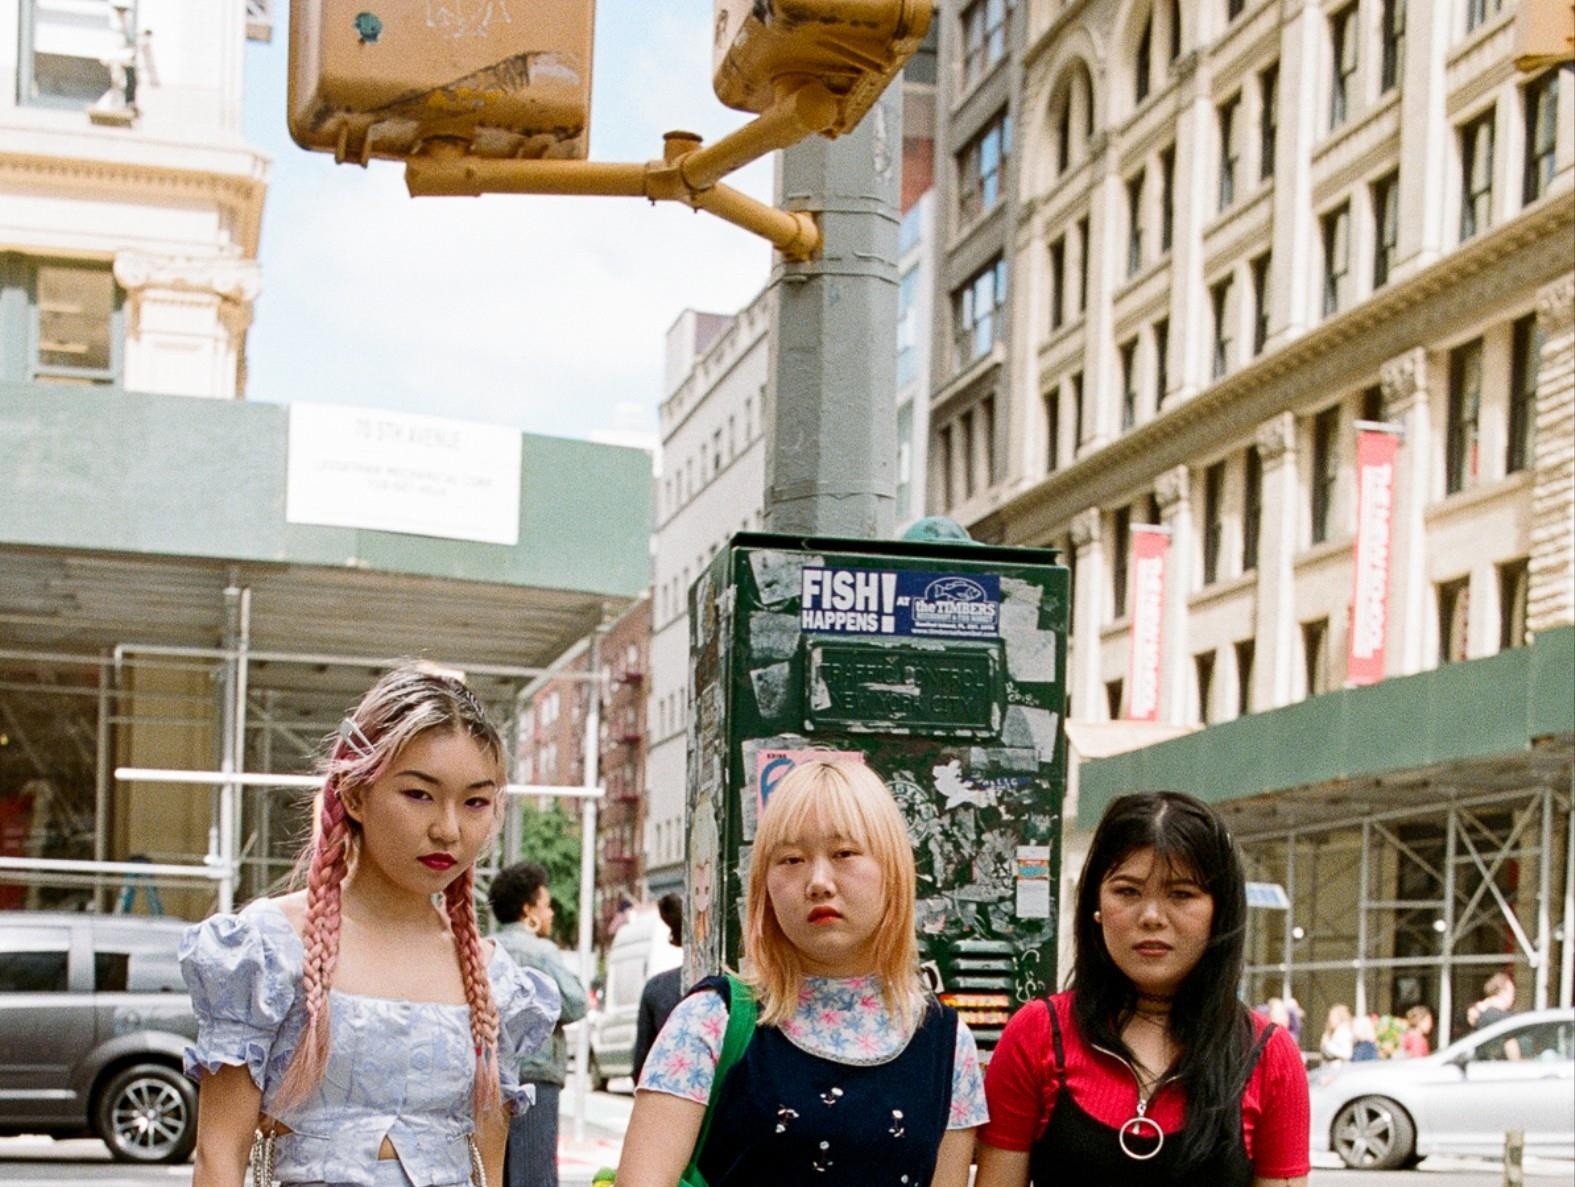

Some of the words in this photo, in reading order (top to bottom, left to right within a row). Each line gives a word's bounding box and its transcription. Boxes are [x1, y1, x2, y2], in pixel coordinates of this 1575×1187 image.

[896, 596, 910, 607] AT
[818, 661, 898, 685] TRAFFIC
[831, 688, 875, 709] NEW
[877, 690, 924, 712] YORK
[931, 693, 975, 714] CITY
